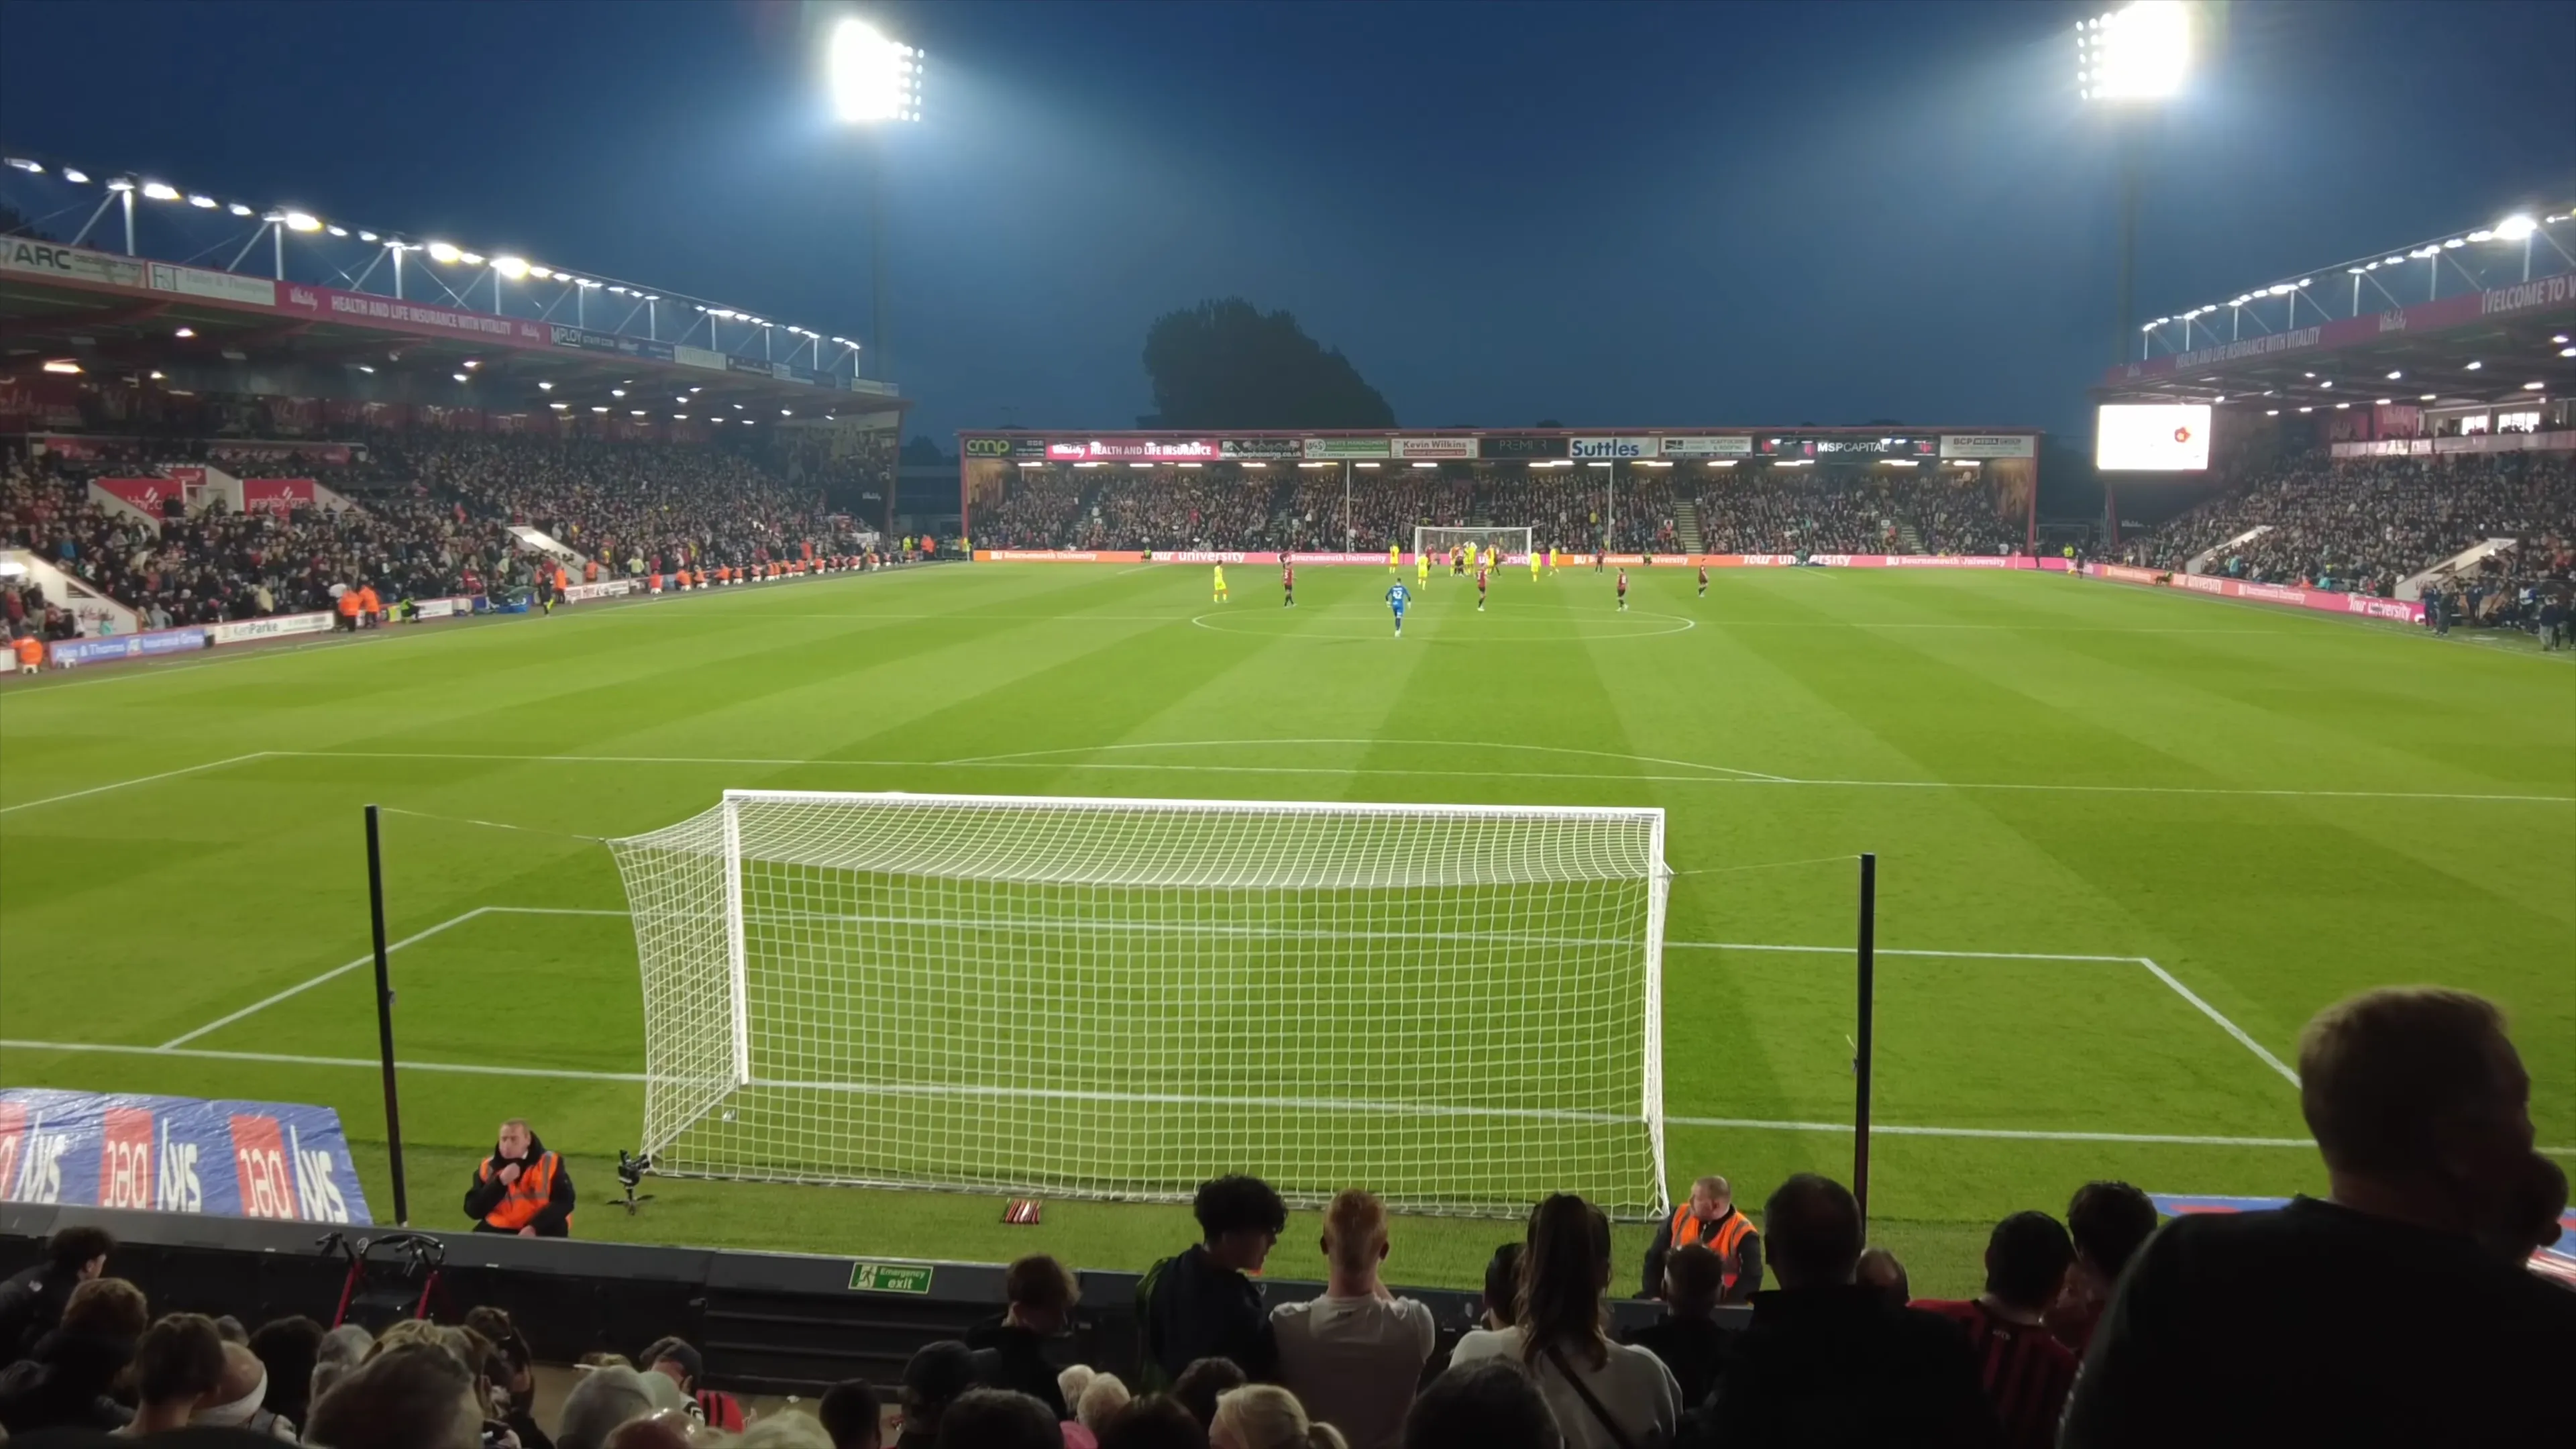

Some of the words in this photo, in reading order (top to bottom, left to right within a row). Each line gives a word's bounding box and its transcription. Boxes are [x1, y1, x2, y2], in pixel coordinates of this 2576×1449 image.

[15, 244, 71, 270] ARC
[2483, 280, 2544, 315] WELCOME
[2548, 277, 2565, 301] TO
[331, 296, 368, 313] HEALTH
[370, 302, 390, 318] AND
[391, 305, 410, 321] LIFE
[411, 308, 457, 327] INSURANCE
[458, 315, 479, 331] WITH
[480, 317, 511, 335] VITALITY
[2226, 337, 2265, 360] INSURANCE
[2266, 334, 2285, 353] WITH
[2287, 327, 2322, 349] VITALITY
[967, 439, 1010, 455] cmp
[1403, 440, 1430, 448] Kevin
[1432, 439, 1466, 448] Wilkins
[1572, 439, 1640, 457] Suttles
[1091, 446, 1122, 455] HEALTH
[1124, 446, 1142, 455] AND
[1144, 446, 1161, 455] LIFE
[1163, 446, 1212, 455] INSURANCE
[991, 551, 1002, 559] BU
[1057, 552, 1097, 561] University
[1152, 552, 1174, 561] our
[1179, 551, 1245, 563] university
[1291, 554, 1344, 562] Bournemouth
[1346, 554, 1387, 564] University
[1574, 555, 1586, 564] BU
[1886, 557, 1899, 566] BU
[1902, 557, 1960, 566] Bournemouth
[1962, 557, 2006, 567] University
[1393, 590, 1403, 599] 42
[879, 1267, 925, 1279] Emergency
[888, 1277, 913, 1289] exit
